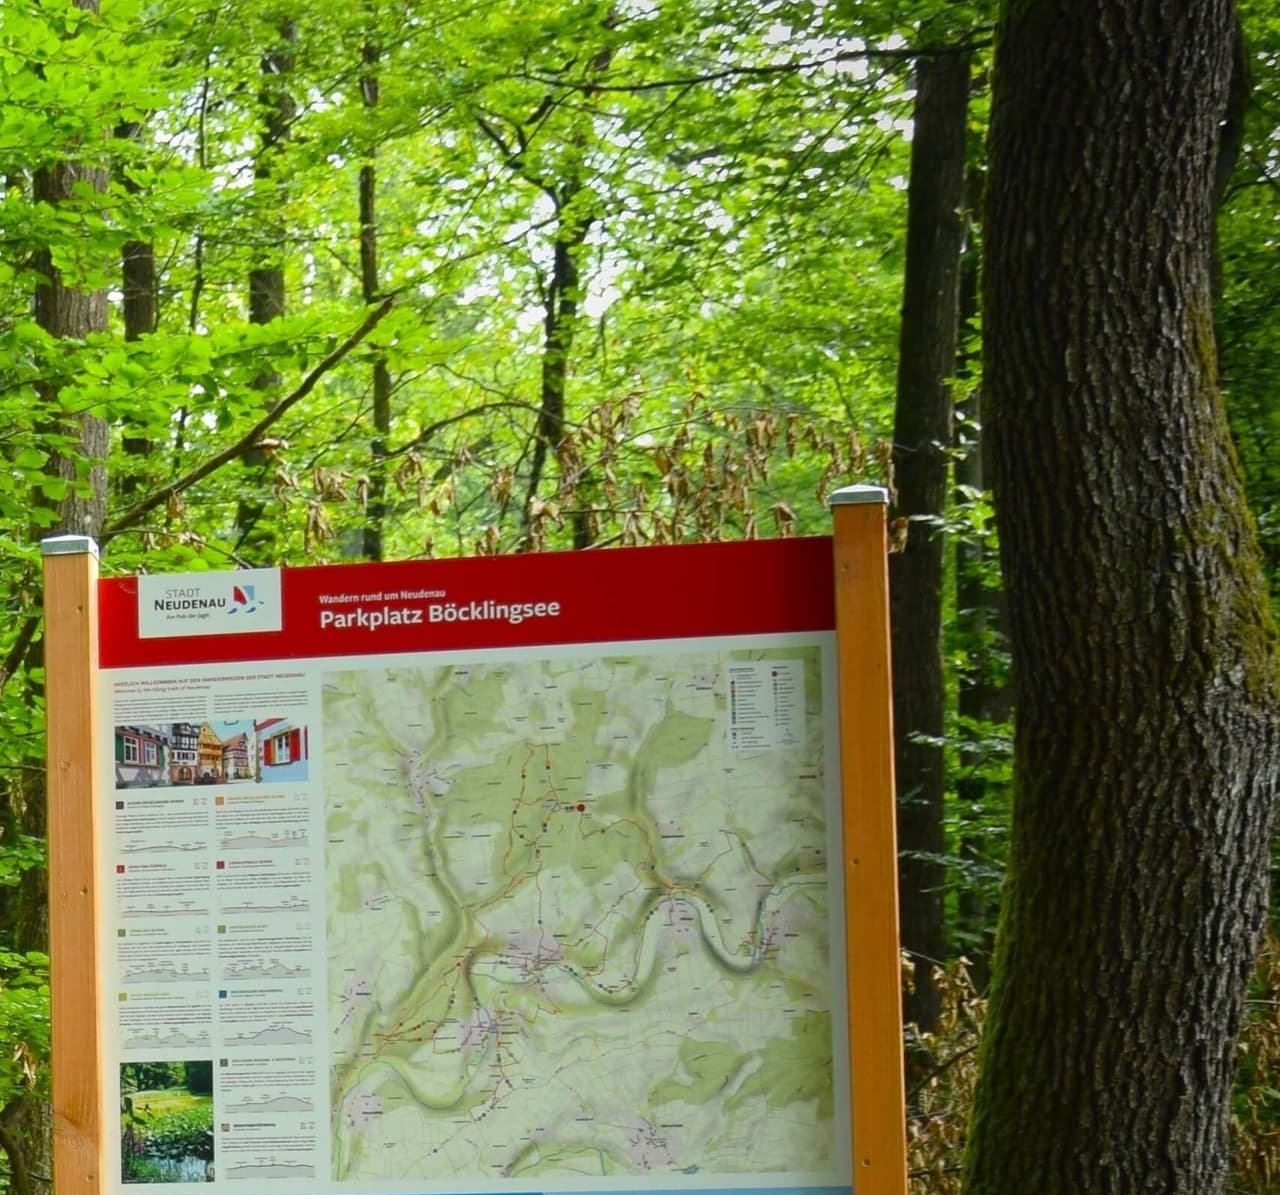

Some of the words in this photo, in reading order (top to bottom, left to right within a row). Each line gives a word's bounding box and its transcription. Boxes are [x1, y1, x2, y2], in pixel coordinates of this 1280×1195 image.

[165, 588, 200, 599] STADT
[319, 593, 359, 604] Wandern
[361, 592, 381, 602] rund
[384, 593, 398, 601] um
[400, 589, 446, 601] Neudenau
[154, 597, 226, 611] NEUDENAU
[320, 606, 423, 631] Parkplatz
[428, 600, 561, 625] Böcklingsee
